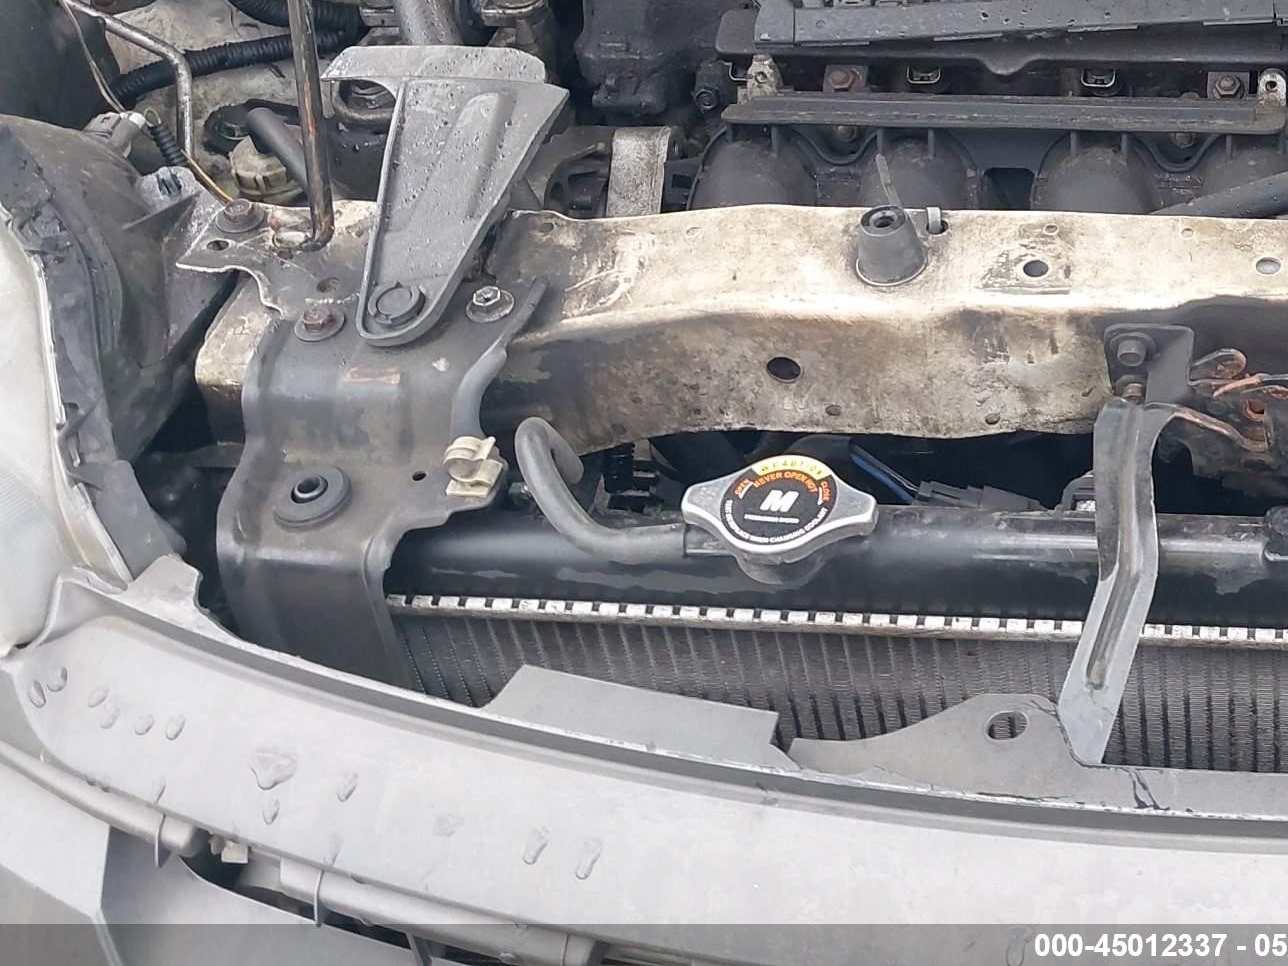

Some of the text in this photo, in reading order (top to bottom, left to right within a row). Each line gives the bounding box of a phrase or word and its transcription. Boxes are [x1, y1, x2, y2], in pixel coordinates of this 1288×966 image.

[734, 478, 751, 495] OPEN
[753, 470, 818, 493] NEVER OPEN HOT
[804, 506, 828, 531] COOLANT
